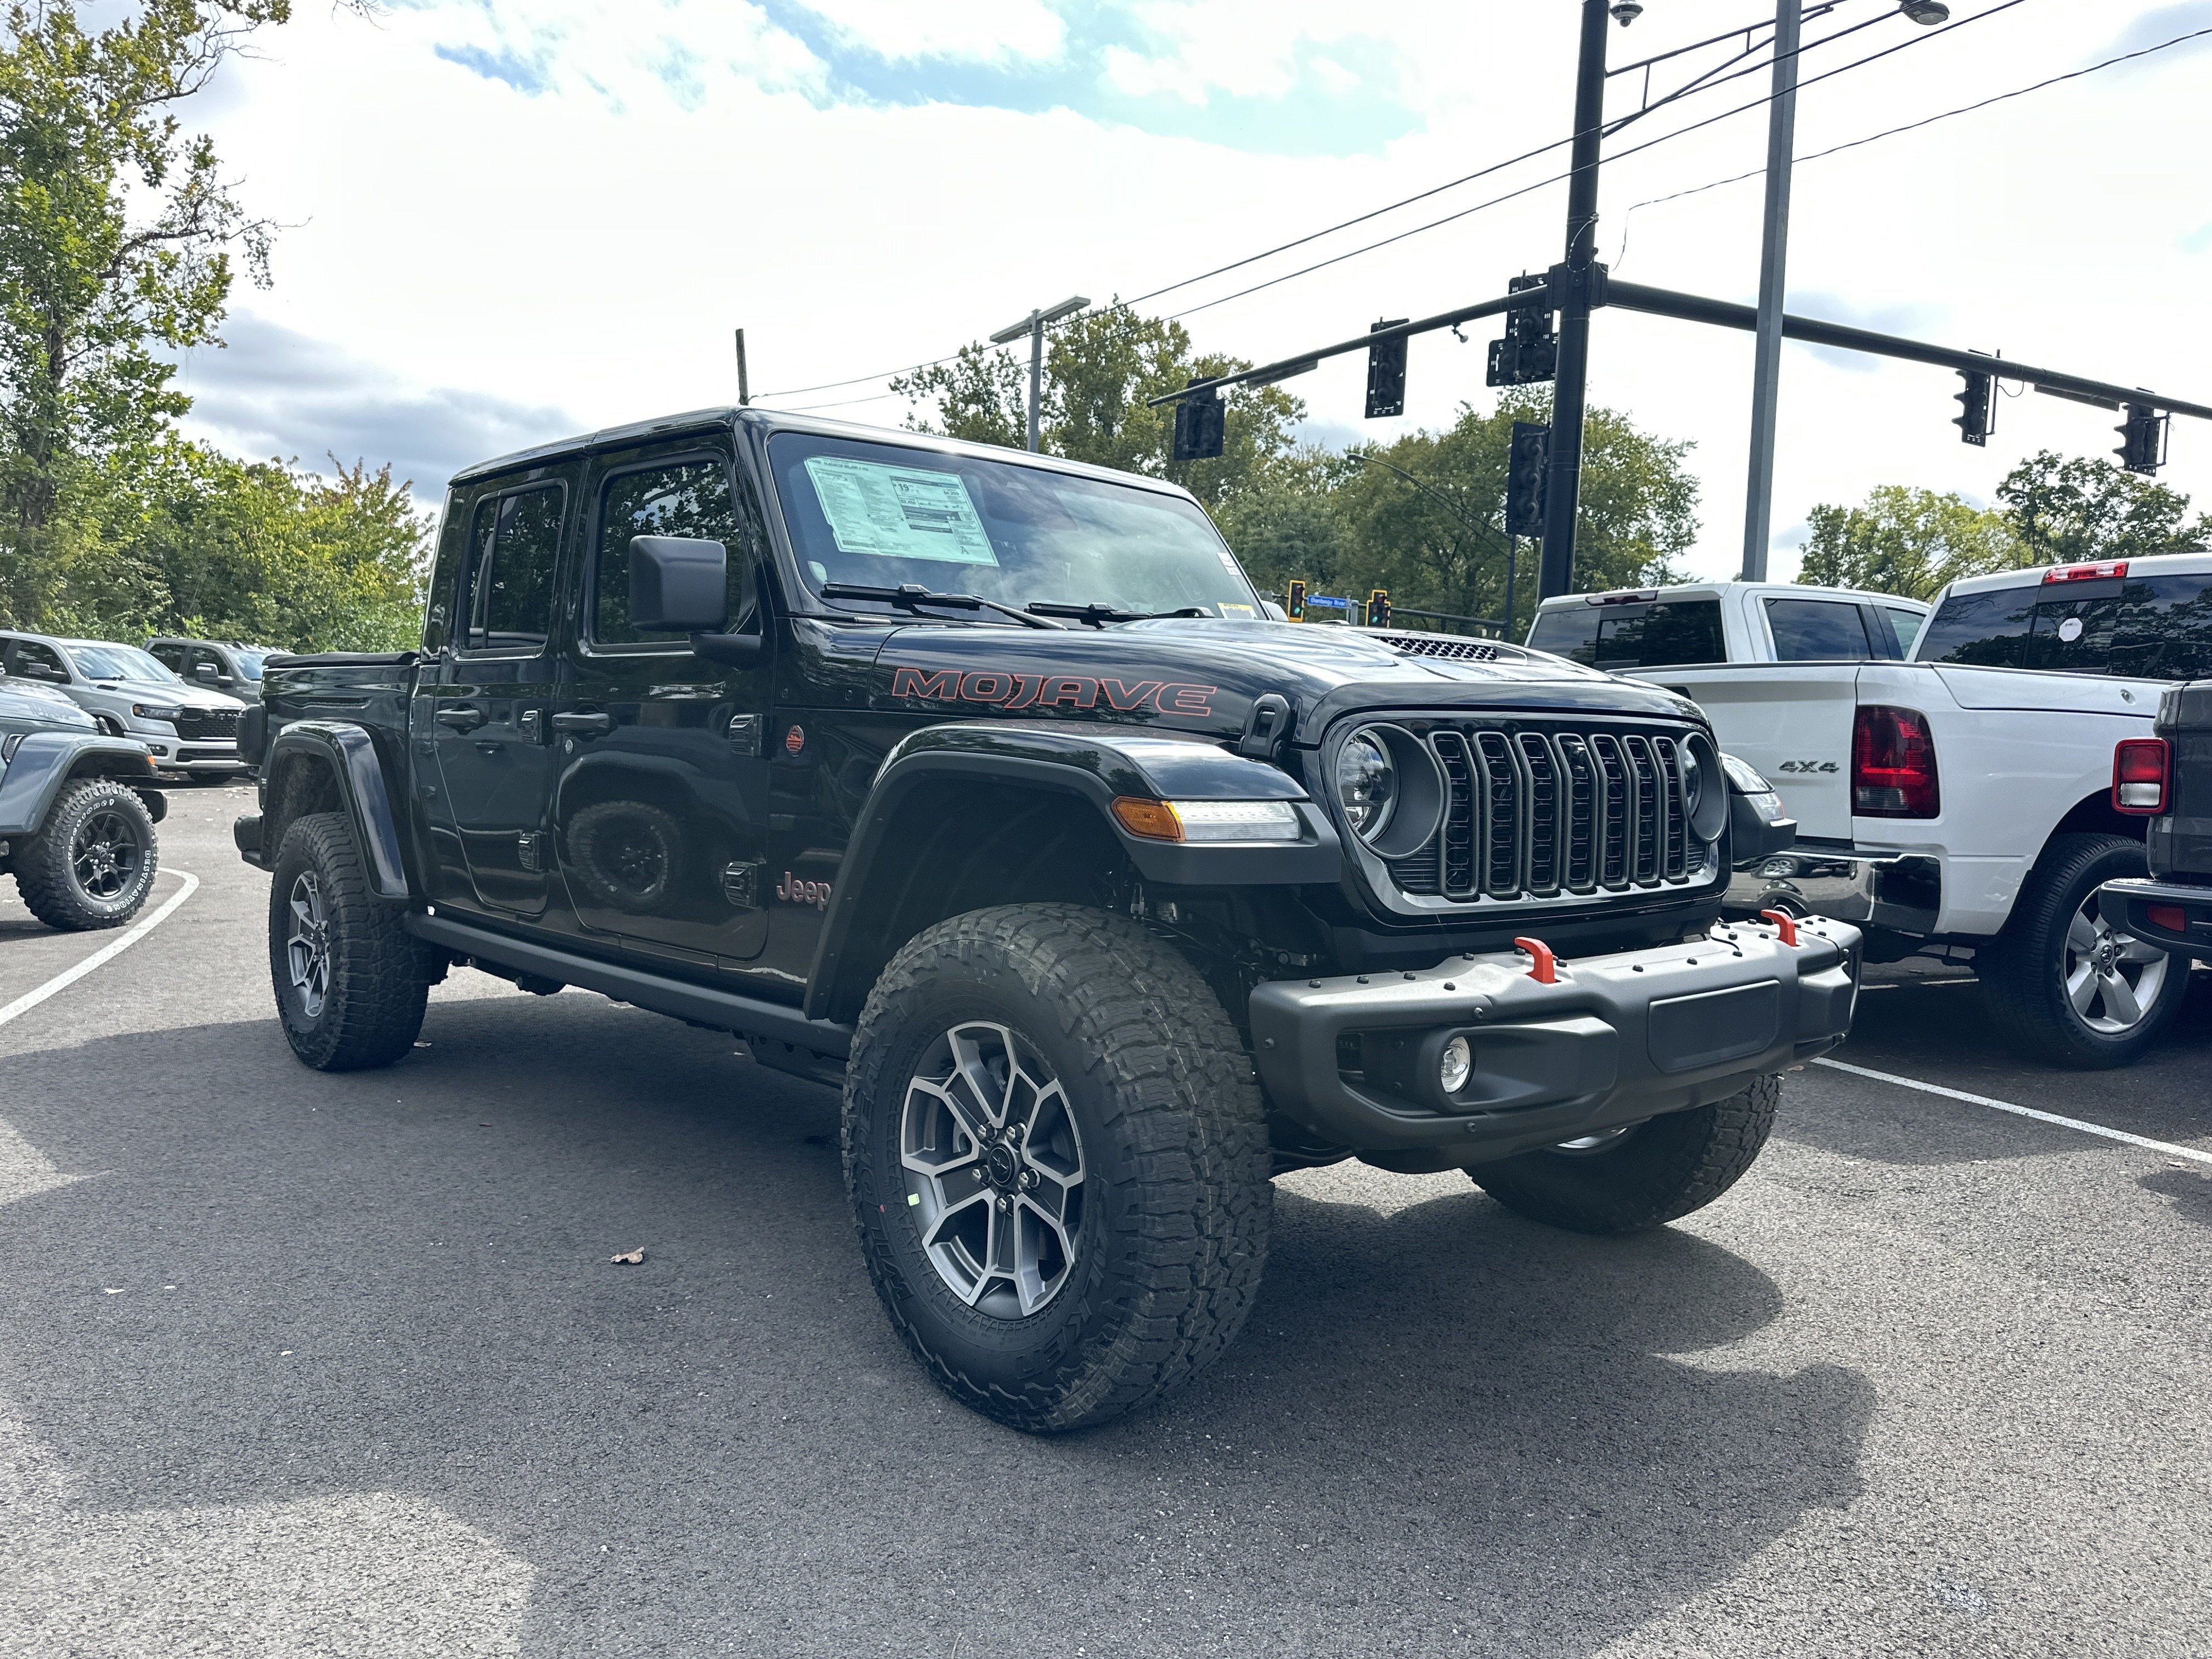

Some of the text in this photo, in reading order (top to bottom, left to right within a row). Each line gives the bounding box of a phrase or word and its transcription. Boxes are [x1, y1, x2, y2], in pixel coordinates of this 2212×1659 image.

[898, 483, 910, 492] 19
[960, 546, 970, 555] A
[891, 668, 1217, 716] MOJAVE
[1779, 760, 1840, 773] 4X4
[113, 850, 151, 912] DESTINATION
[776, 871, 832, 912] Jeep
